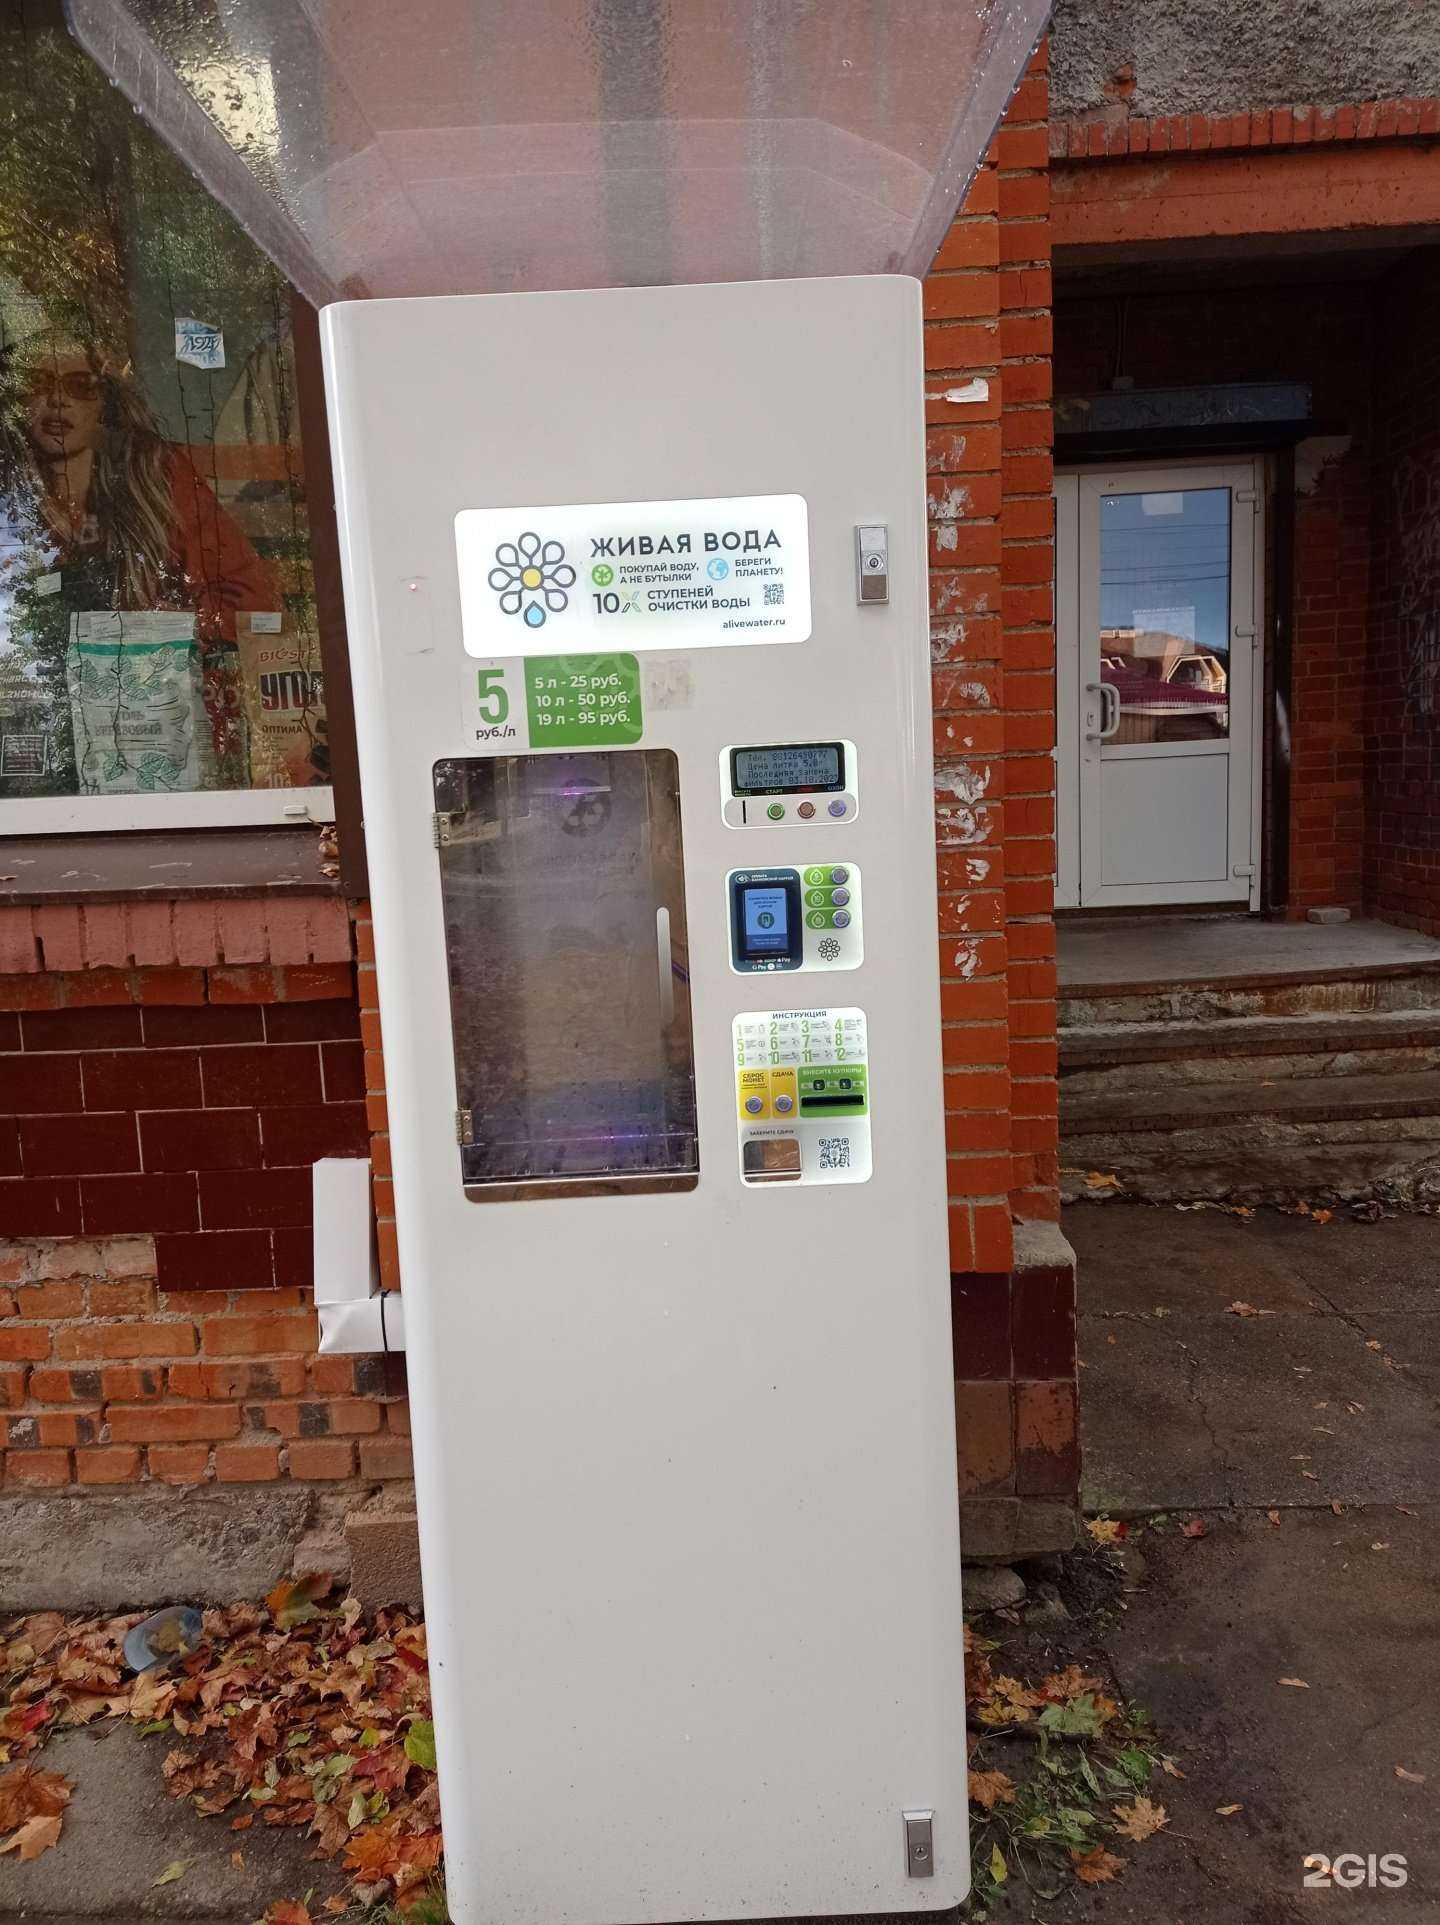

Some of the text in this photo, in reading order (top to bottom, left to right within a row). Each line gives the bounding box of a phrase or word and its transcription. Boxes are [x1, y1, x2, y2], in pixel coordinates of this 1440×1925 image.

[590, 529, 782, 558] ЖИВАЯ ВОДА
[619, 562, 699, 574] ПОКУПАЙ ВОДУ,
[735, 558, 771, 567] БЕРЕГИ
[735, 567, 784, 577] ПЛАНЕТУ!
[630, 576, 643, 584] НЕ
[645, 574, 692, 583] БУТЫЛКИ
[648, 585, 714, 599] СТУПЕНЕЙ
[648, 597, 750, 612] ОЧИСТКИ ВОДЫ
[723, 618, 786, 629] alivewater.ru
[535, 677, 543, 689] 5
[547, 679, 557, 689] л
[570, 675, 588, 688] 25
[591, 673, 622, 690] руб.
[478, 669, 509, 724] 5
[536, 695, 551, 707] 10
[555, 697, 565, 707] л
[578, 693, 596, 706] 50
[600, 691, 631, 708] руб.
[536, 713, 551, 726] 19
[555, 715, 565, 725] л
[578, 712, 596, 724] 95
[600, 710, 631, 727] руб.
[476, 725, 516, 741] руб./л
[748, 769, 794, 779] Последняя
[772, 1011, 827, 1020] ИНСТРУКЦИЯ
[737, 1024, 742, 1037] 1
[770, 1022, 778, 1035] 2
[801, 1020, 809, 1033] 3
[834, 1018, 843, 1031] 4
[737, 1038, 744, 1052] 5
[770, 1036, 778, 1050] 6
[802, 1035, 810, 1048] 7
[835, 1033, 842, 1046] 8
[737, 1053, 745, 1066] 9
[768, 1051, 779, 1065] 10
[802, 1049, 812, 1063] 11
[834, 1047, 846, 1061] 12
